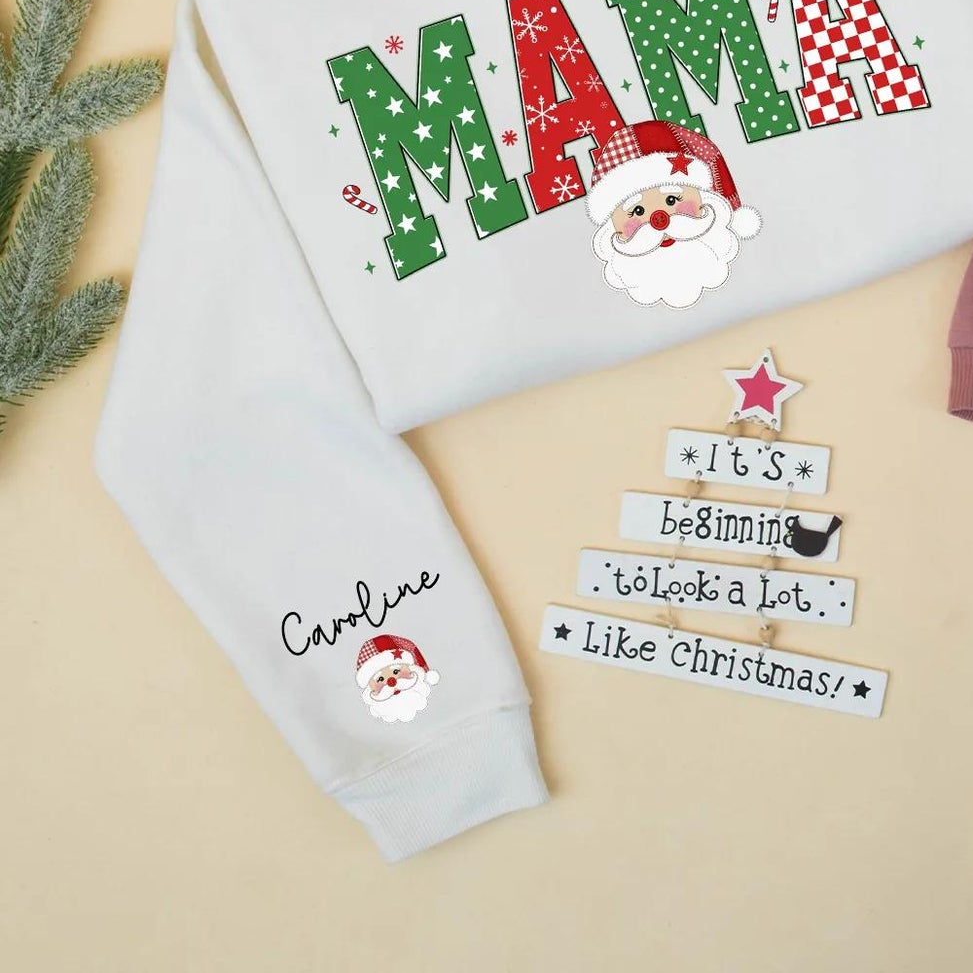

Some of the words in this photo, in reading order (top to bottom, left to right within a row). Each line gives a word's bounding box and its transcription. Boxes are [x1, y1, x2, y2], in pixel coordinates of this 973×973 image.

[660, 500, 801, 548] beginning
[281, 571, 440, 656] Caroline
[727, 580, 746, 607] a
[582, 621, 657, 662] Like
